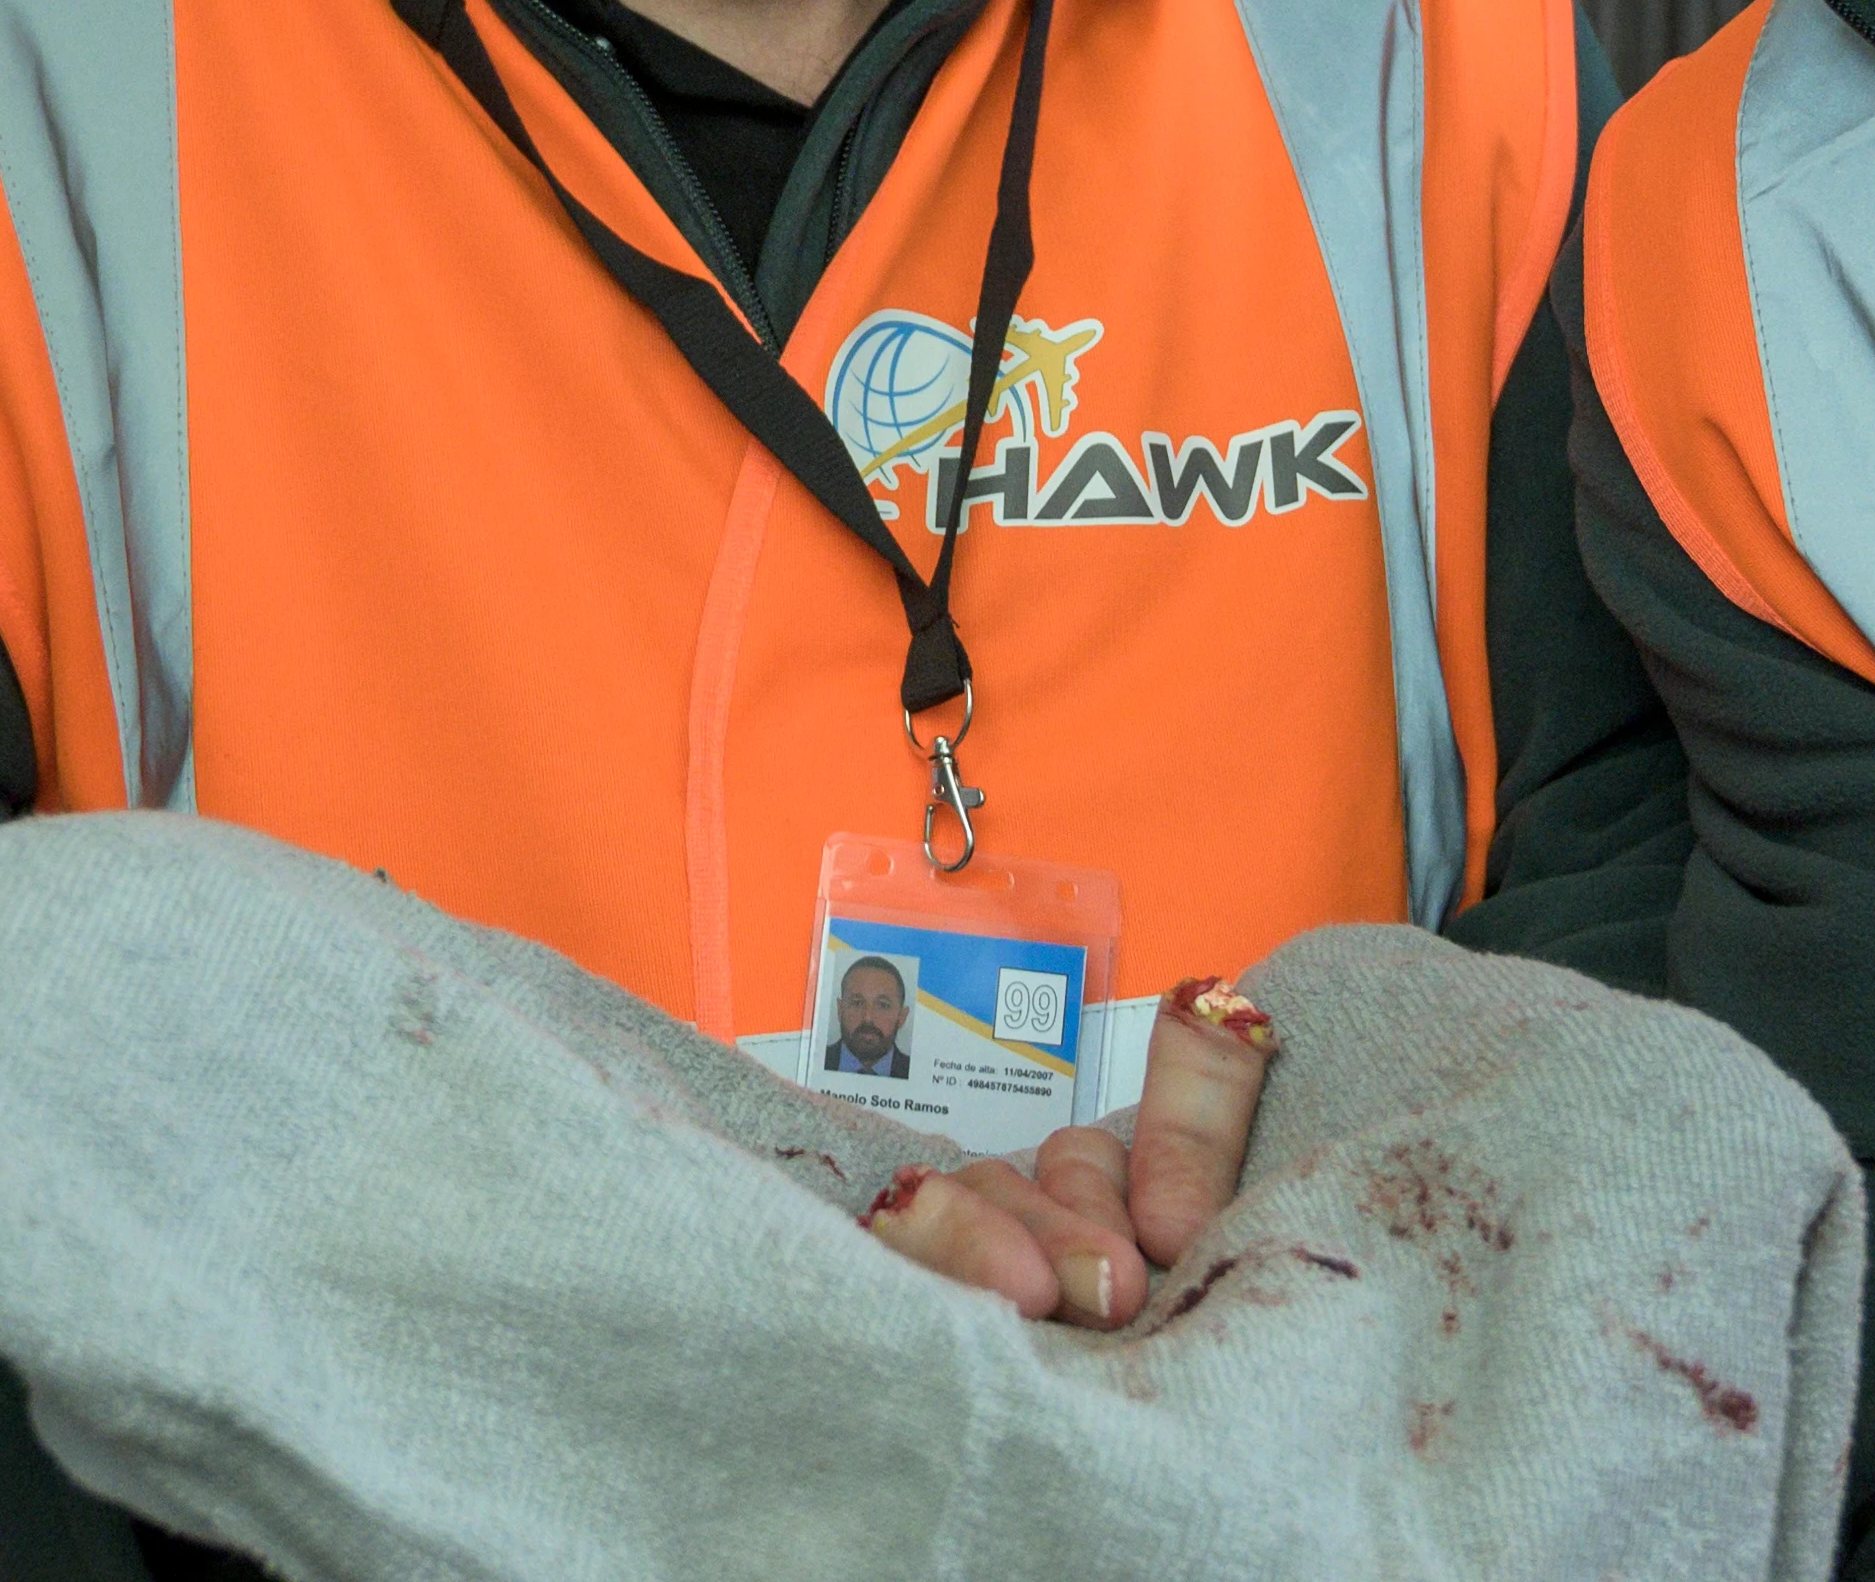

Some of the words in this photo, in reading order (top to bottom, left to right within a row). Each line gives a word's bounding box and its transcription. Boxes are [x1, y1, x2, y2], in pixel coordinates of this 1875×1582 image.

[933, 419, 1365, 530] HAWK
[1003, 980, 1059, 1033] 99
[933, 1058, 962, 1071] Fecha
[964, 1062, 976, 1073] de
[1004, 1067, 1054, 1081] 11/04/2007
[870, 1094, 901, 1110] Soto
[904, 1098, 950, 1115] Ramos
